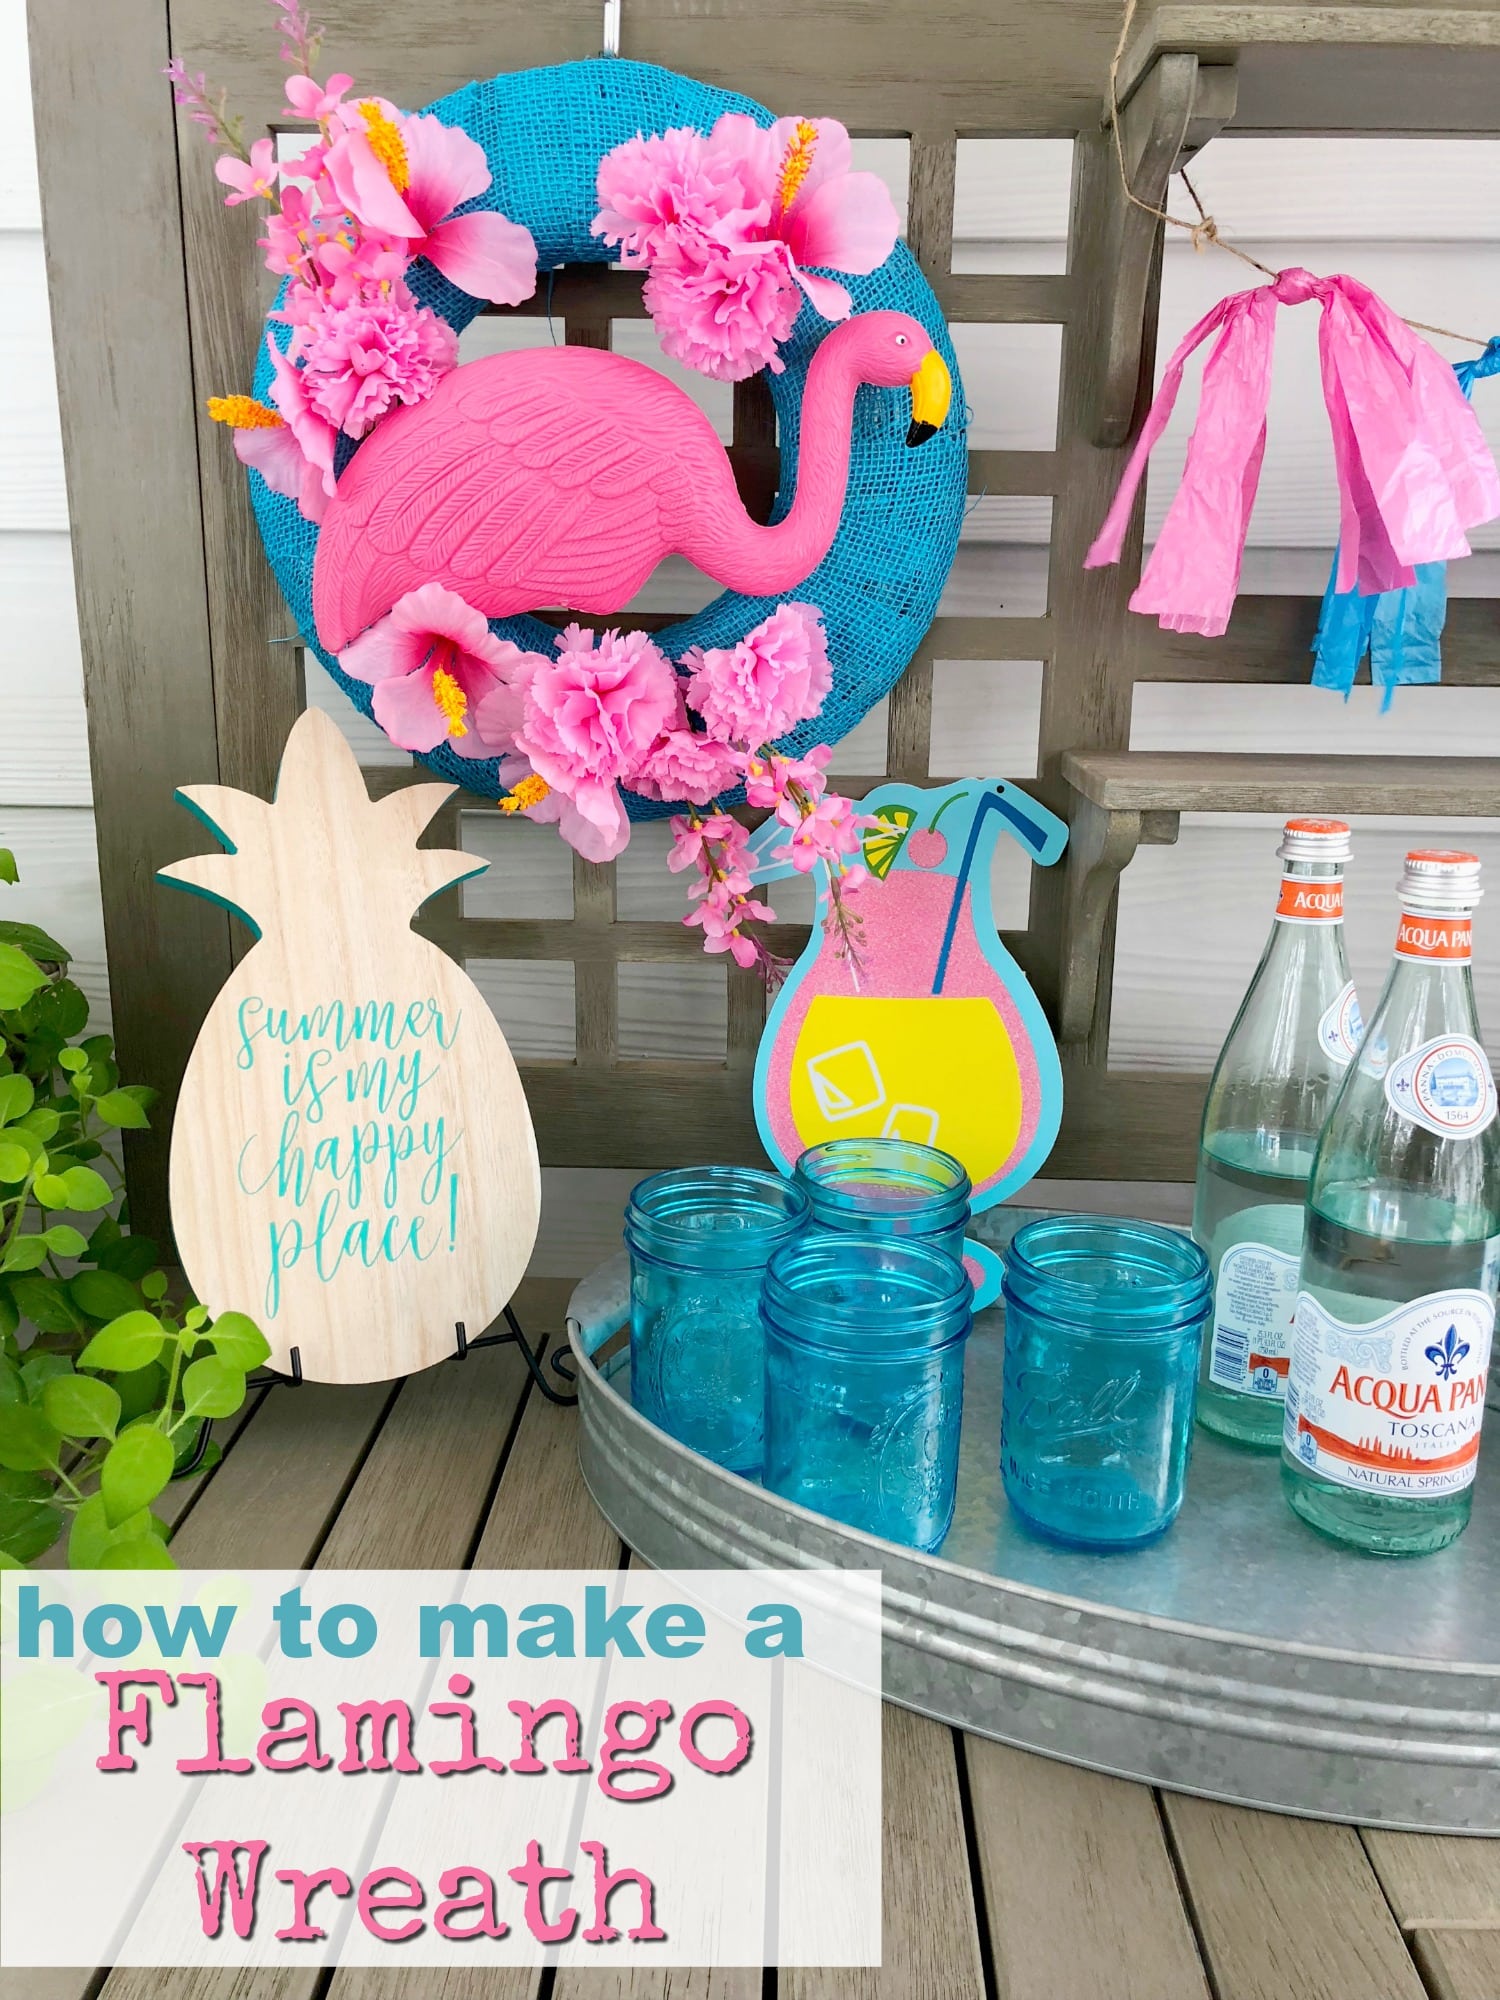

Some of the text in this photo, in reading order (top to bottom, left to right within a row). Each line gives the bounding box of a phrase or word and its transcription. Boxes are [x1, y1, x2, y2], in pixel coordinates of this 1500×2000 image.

[1294, 891, 1341, 912] ACQUA
[1398, 923, 1449, 951] ACQUA
[283, 1049, 441, 1124] is my
[1444, 1110, 1469, 1121] 1564
[238, 1110, 464, 1210] happy
[265, 1173, 458, 1320] place!
[1263, 1368, 1269, 1379] 0
[1329, 1364, 1442, 1420] ACQUA
[1388, 1416, 1476, 1439] TOSCANA
[1347, 1466, 1414, 1489] NATURAL
[1416, 1471, 1461, 1488] SPRING
